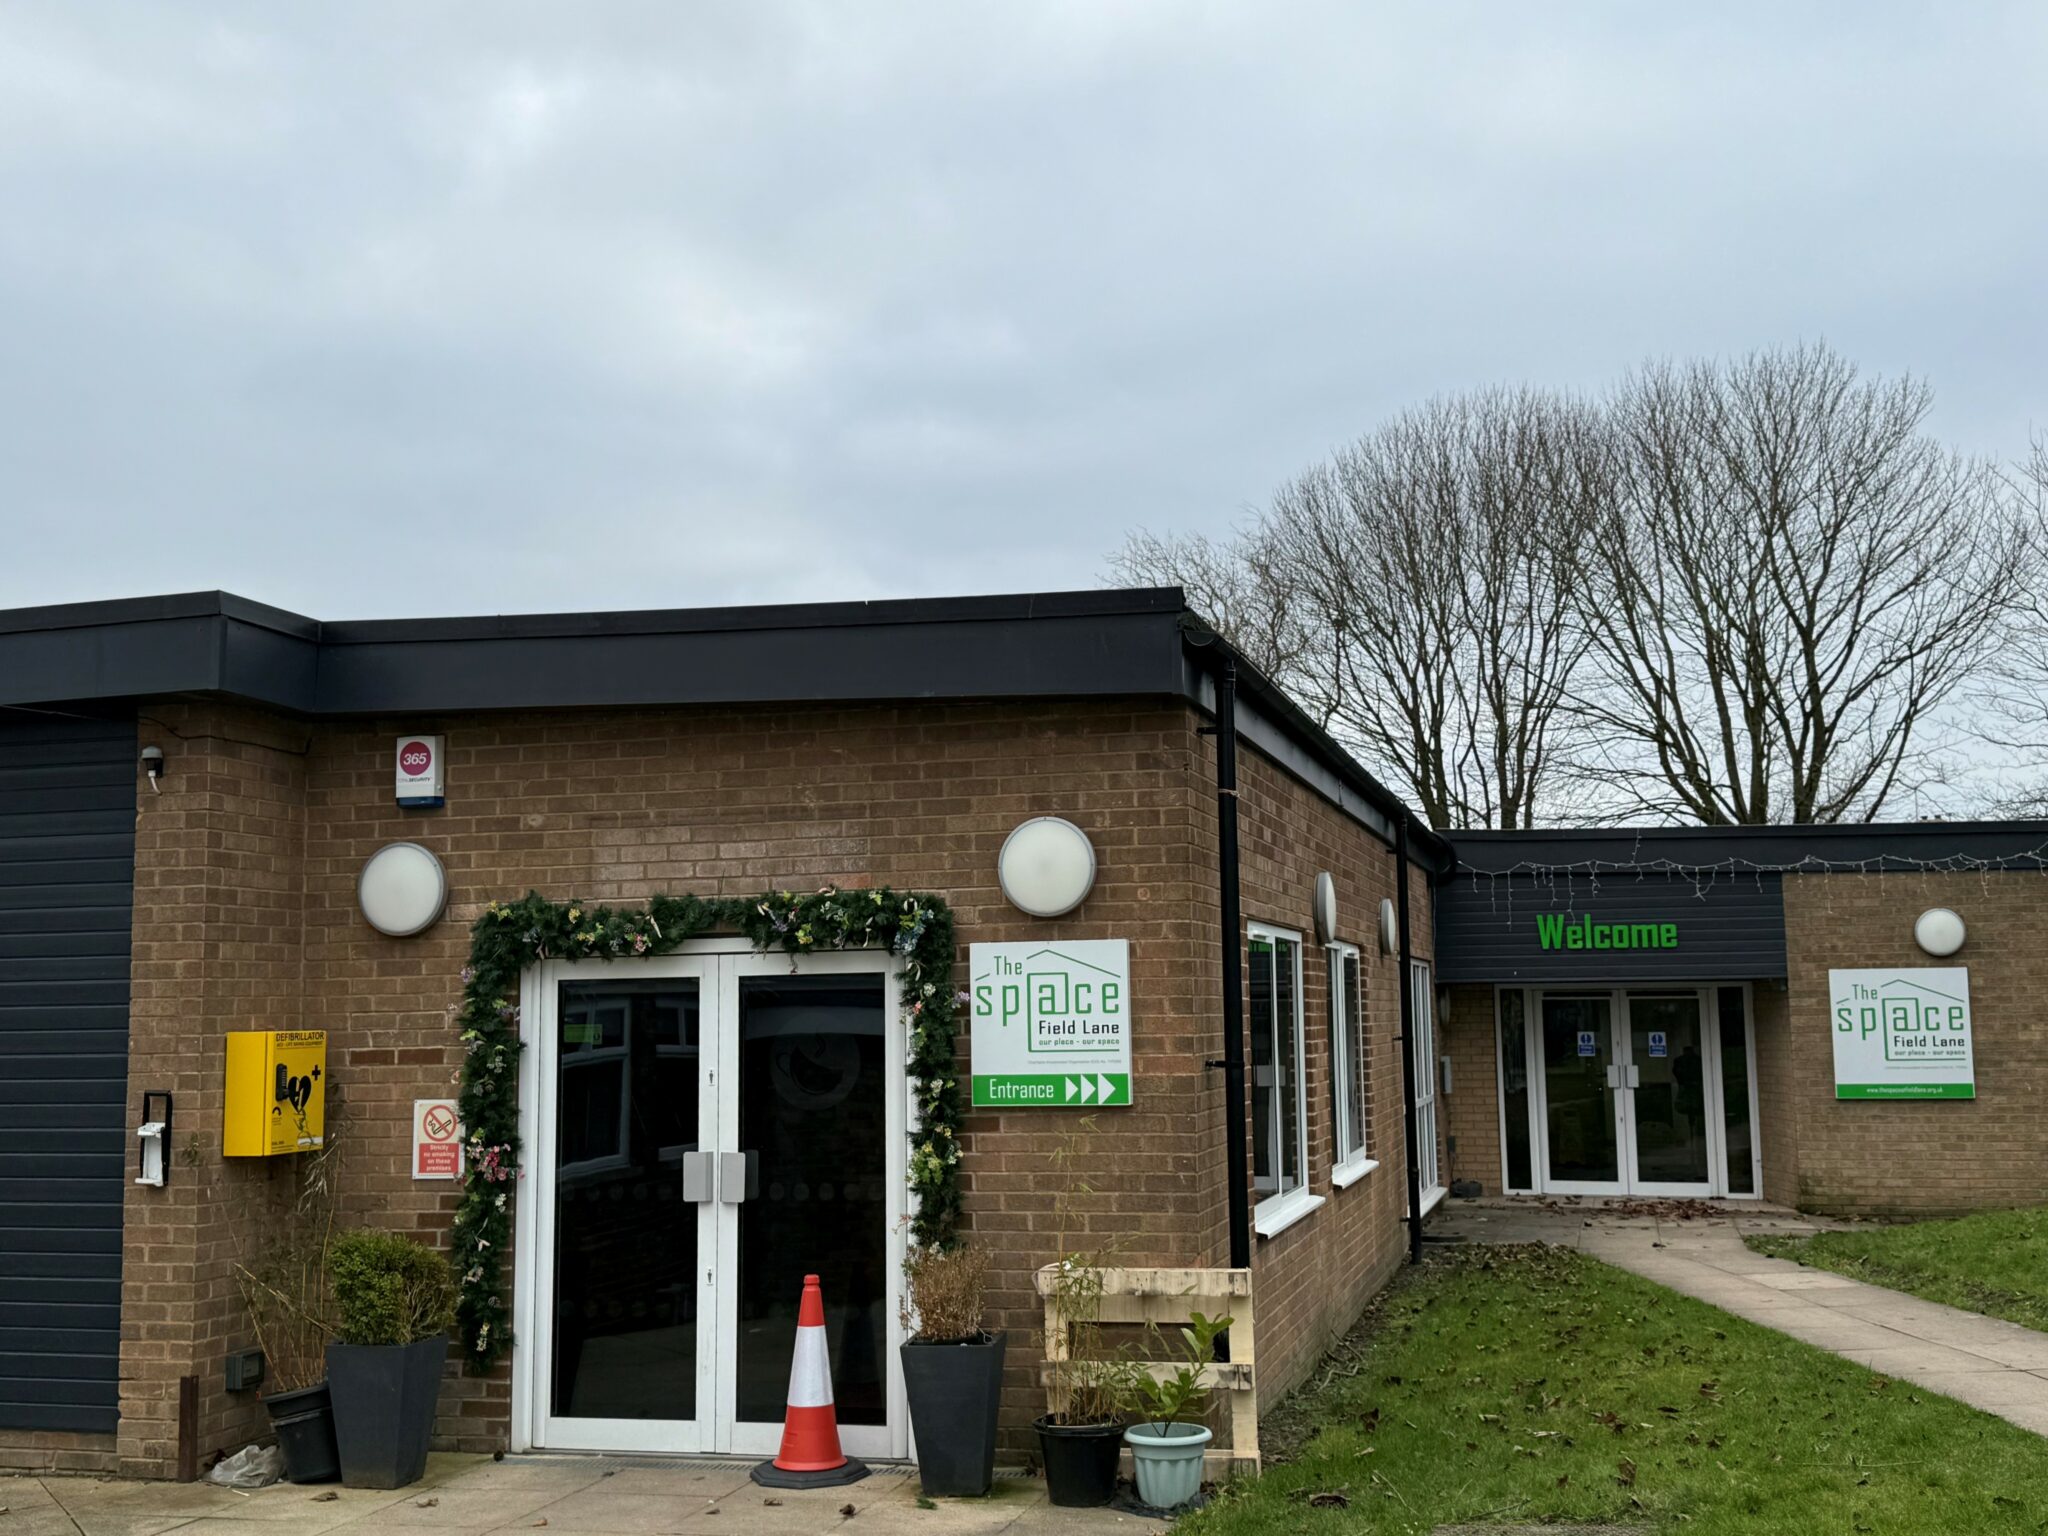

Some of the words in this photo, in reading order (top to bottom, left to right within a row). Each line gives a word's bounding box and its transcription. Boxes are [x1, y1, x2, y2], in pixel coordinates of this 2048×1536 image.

[403, 753, 427, 766] 365
[1536, 913, 1679, 950] Welcome
[994, 956, 1023, 976] The
[1852, 984, 1878, 1000] The
[1039, 1020, 1076, 1035] Field
[1083, 1019, 1120, 1034] Lane
[276, 1031, 325, 1042] DEFIBRILLATOR
[1054, 1037, 1074, 1047] place
[1098, 1038, 1120, 1046] space
[1894, 1035, 1927, 1048] Field
[1932, 1035, 1965, 1048] Lane
[1908, 1047, 1926, 1057] place
[1932, 1048, 1945, 1056] our
[1946, 1048, 1966, 1056] space
[989, 1078, 1055, 1099] Entrance
[430, 1144, 448, 1152] Strictly
[432, 1151, 456, 1159] smoking
